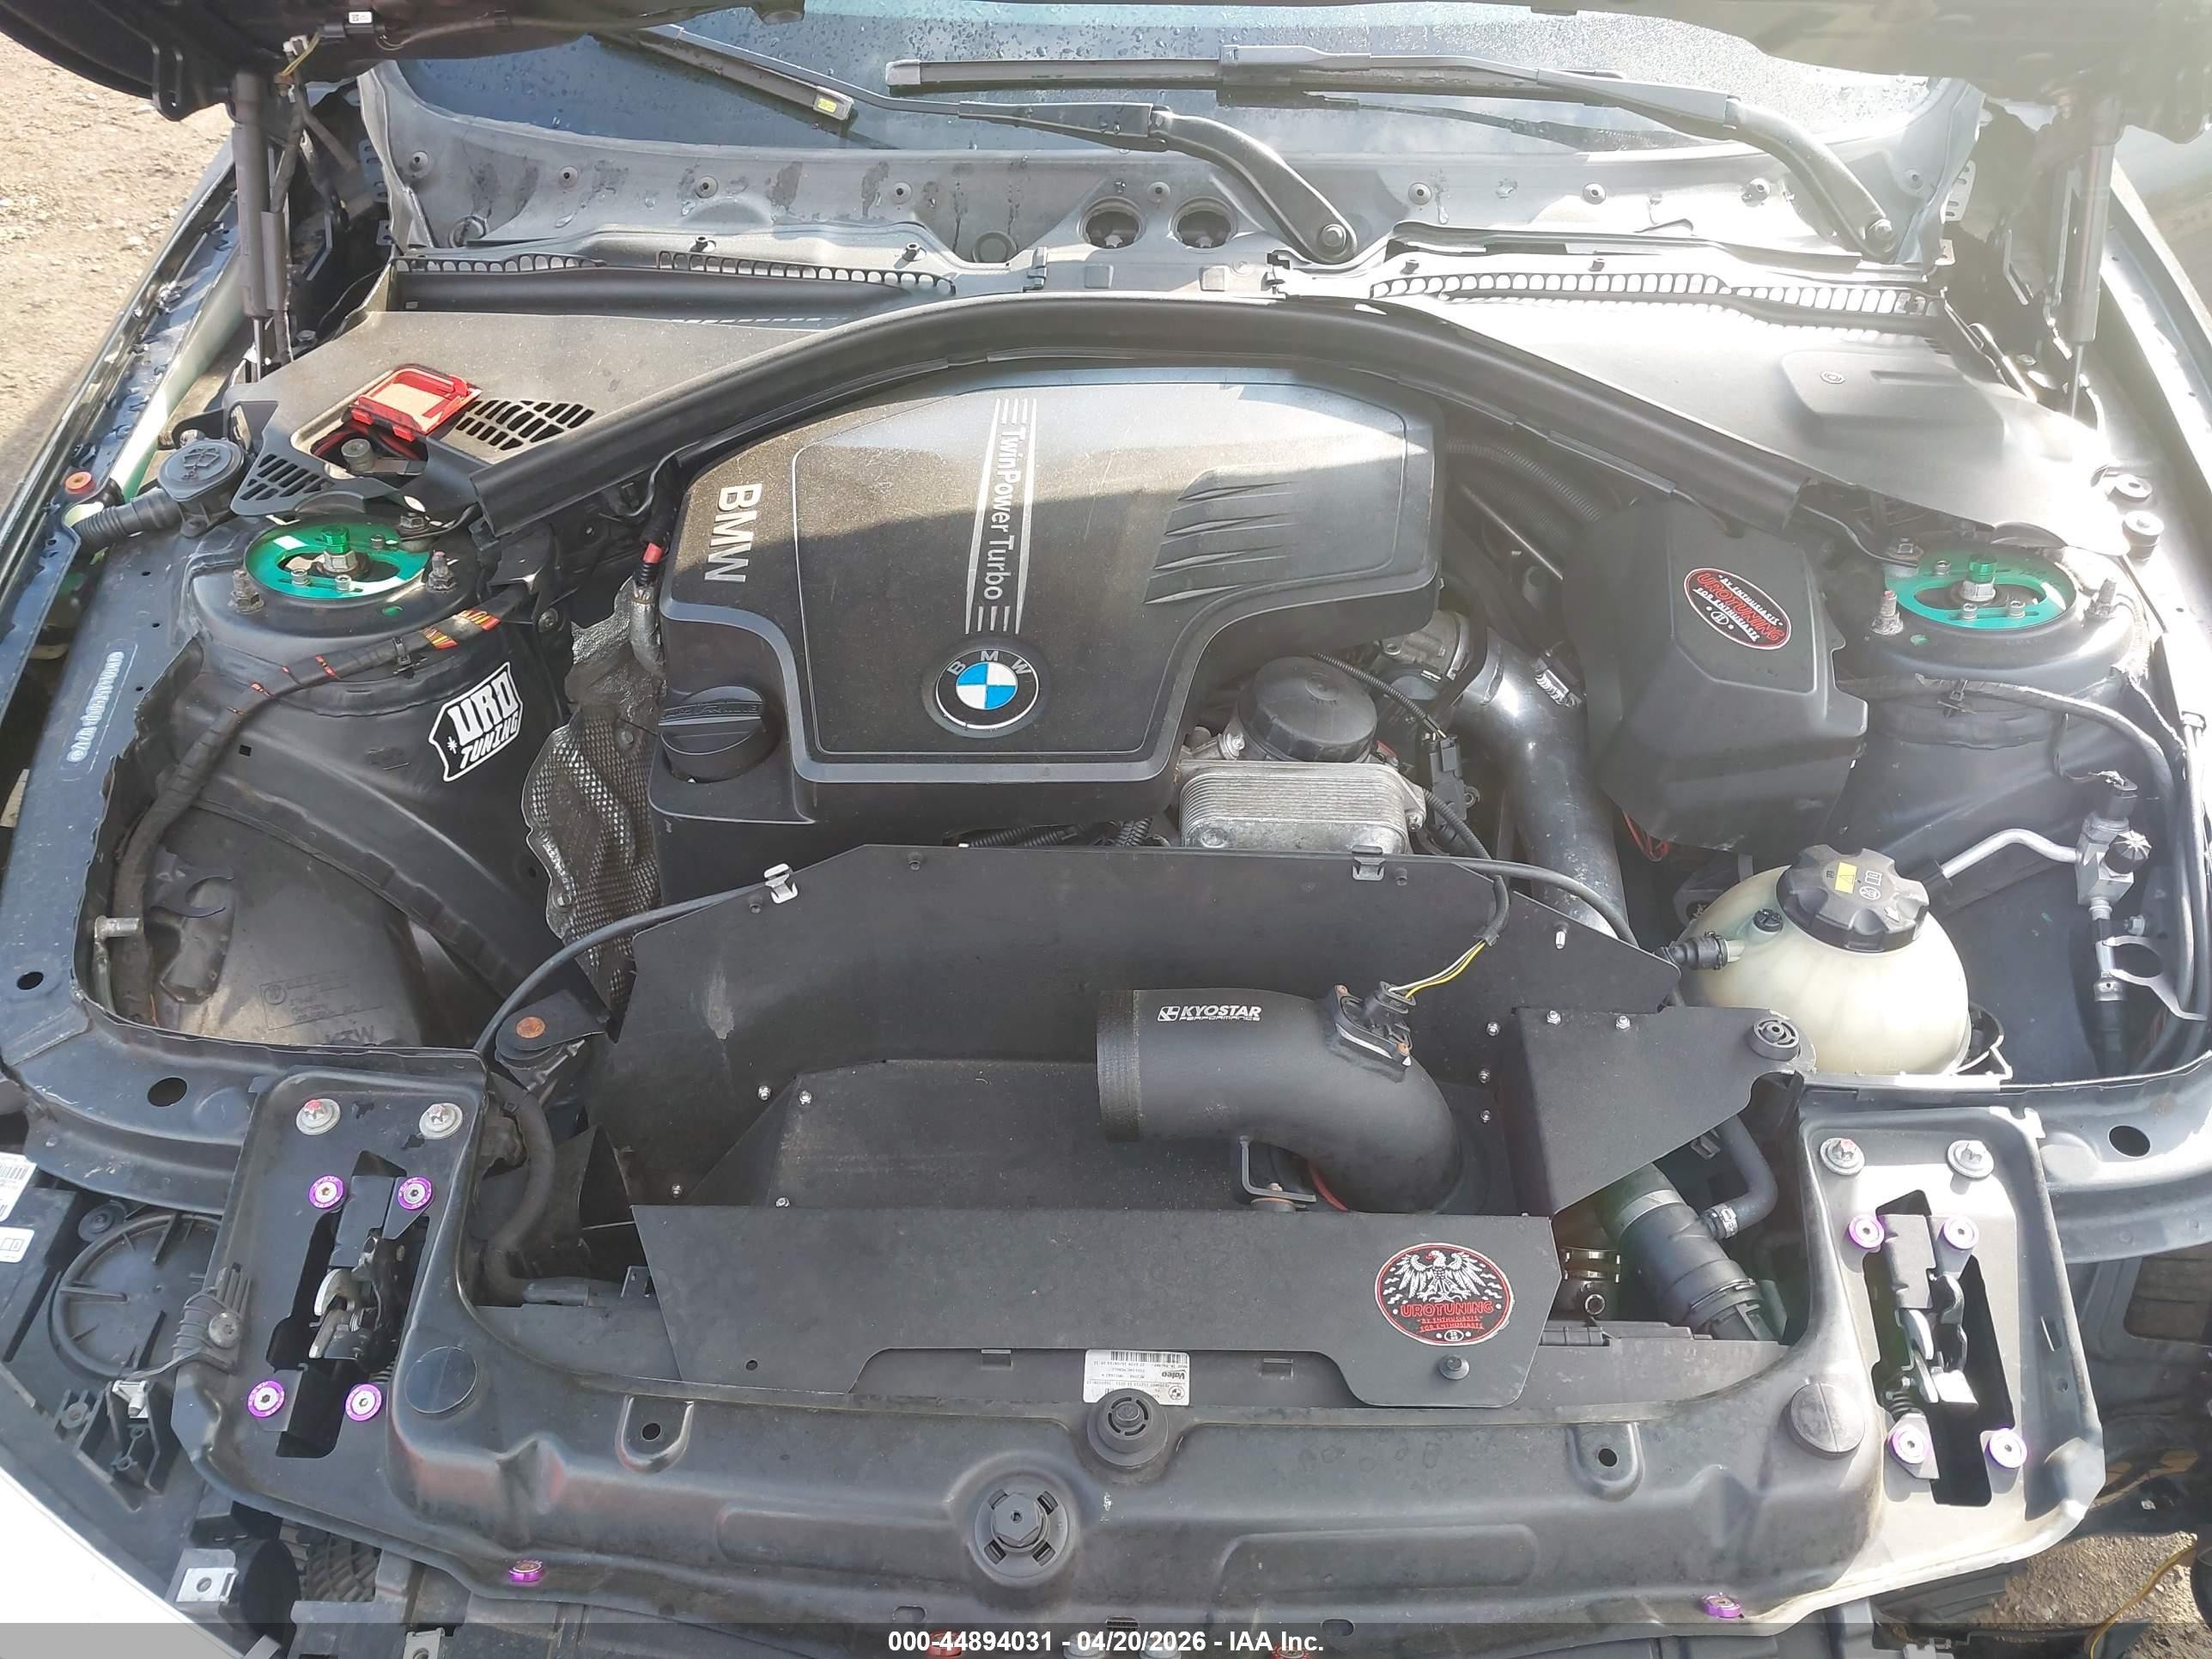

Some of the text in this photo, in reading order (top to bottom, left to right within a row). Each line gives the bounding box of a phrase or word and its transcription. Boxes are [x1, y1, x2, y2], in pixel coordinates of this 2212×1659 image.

[704, 483, 763, 583] BMW
[982, 427, 1026, 601] TwinPower Turbo
[1696, 587, 1714, 600] FOR
[1698, 573, 1785, 641] UROTUNING
[945, 650, 1032, 676] BMW
[447, 671, 519, 746] URO
[459, 710, 519, 769] TUNING
[1181, 1005, 1262, 1017] KYOSTAR
[1401, 1301, 1494, 1318] UROTUNING
[1161, 1370, 1185, 1380] Valeo
